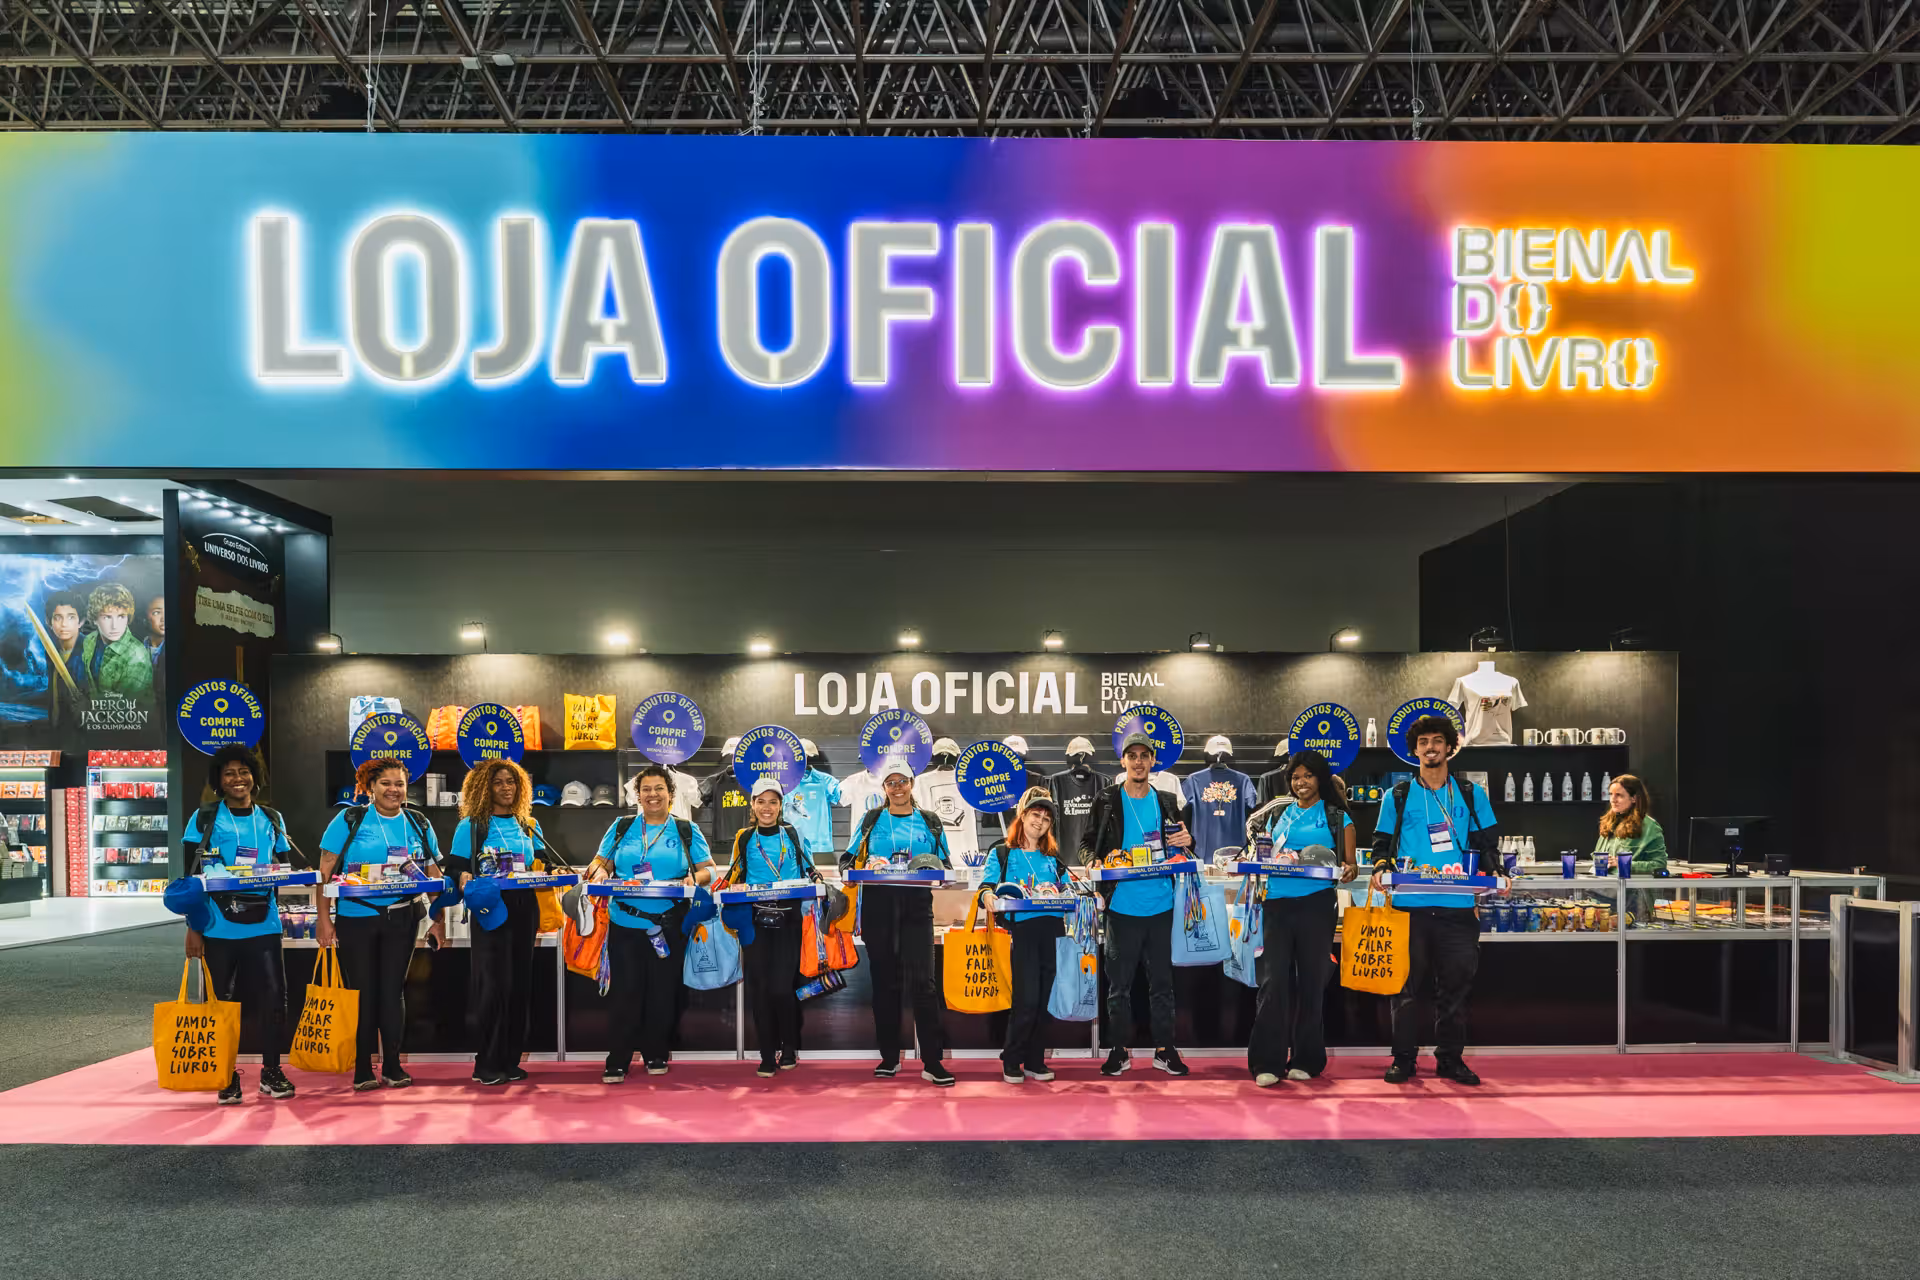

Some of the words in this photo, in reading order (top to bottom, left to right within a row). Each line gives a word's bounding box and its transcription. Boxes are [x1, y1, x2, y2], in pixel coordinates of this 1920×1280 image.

[1455, 227, 1695, 283] BIENAL
[253, 213, 666, 384] LOJA
[717, 215, 1403, 389] OFICIAL
[1455, 282, 1552, 335] DO
[1454, 336, 1659, 390] LIVRO
[204, 541, 236, 561] UNIVERSO
[237, 553, 248, 566] DOS
[249, 558, 269, 573] LIVROS
[1101, 672, 1165, 687] BIENAL
[180, 681, 226, 718] PRODUTOS
[229, 684, 262, 719] OFICIAS
[794, 672, 898, 715] LOJA
[911, 671, 1088, 715] OFICIAL
[1101, 686, 1127, 700] DO
[91, 699, 136, 711] PERCY
[633, 693, 676, 726] PRODUTOS
[678, 697, 702, 732] OFICIAS
[80, 710, 148, 726] JACKSON
[200, 717, 245, 727] COMPRE
[459, 704, 497, 738] PRODUTOS
[499, 708, 522, 743] OFICIAS
[1115, 707, 1158, 734] PRODUTOS
[1290, 705, 1331, 740] PRODUTOS
[1333, 707, 1358, 740] OFICIAS
[1390, 700, 1430, 735] PRODUTOS
[211, 728, 236, 738] AQUI
[353, 714, 396, 751] PRODUTOS
[399, 717, 429, 750] OFICIAS
[648, 726, 686, 738] COMPRE
[862, 711, 900, 747] PRODUTOS
[903, 713, 930, 745] OFICIAS
[473, 738, 509, 750] COMPRE
[655, 736, 678, 748] AQUI
[735, 728, 774, 763] PRODUTOS
[776, 729, 803, 762] OFICIAS
[1304, 738, 1342, 748] COMPRE
[370, 749, 412, 759] COMPRE
[751, 761, 788, 771] COMPRE
[957, 742, 989, 783] PRODUTOS
[992, 743, 1022, 771] OFICIAS
[974, 772, 1011, 787] COMPRE
[984, 784, 1006, 796] AQUI
[1357, 938, 1393, 952] FALAR
[1354, 952, 1393, 966] SOBRE
[964, 972, 997, 984] SOBRE
[176, 1015, 216, 1028] VAMOS
[301, 1010, 332, 1026] FALAR
[175, 1031, 216, 1044] FALAR
[297, 1024, 331, 1040] SOBRE
[172, 1045, 216, 1060] SOBRE
